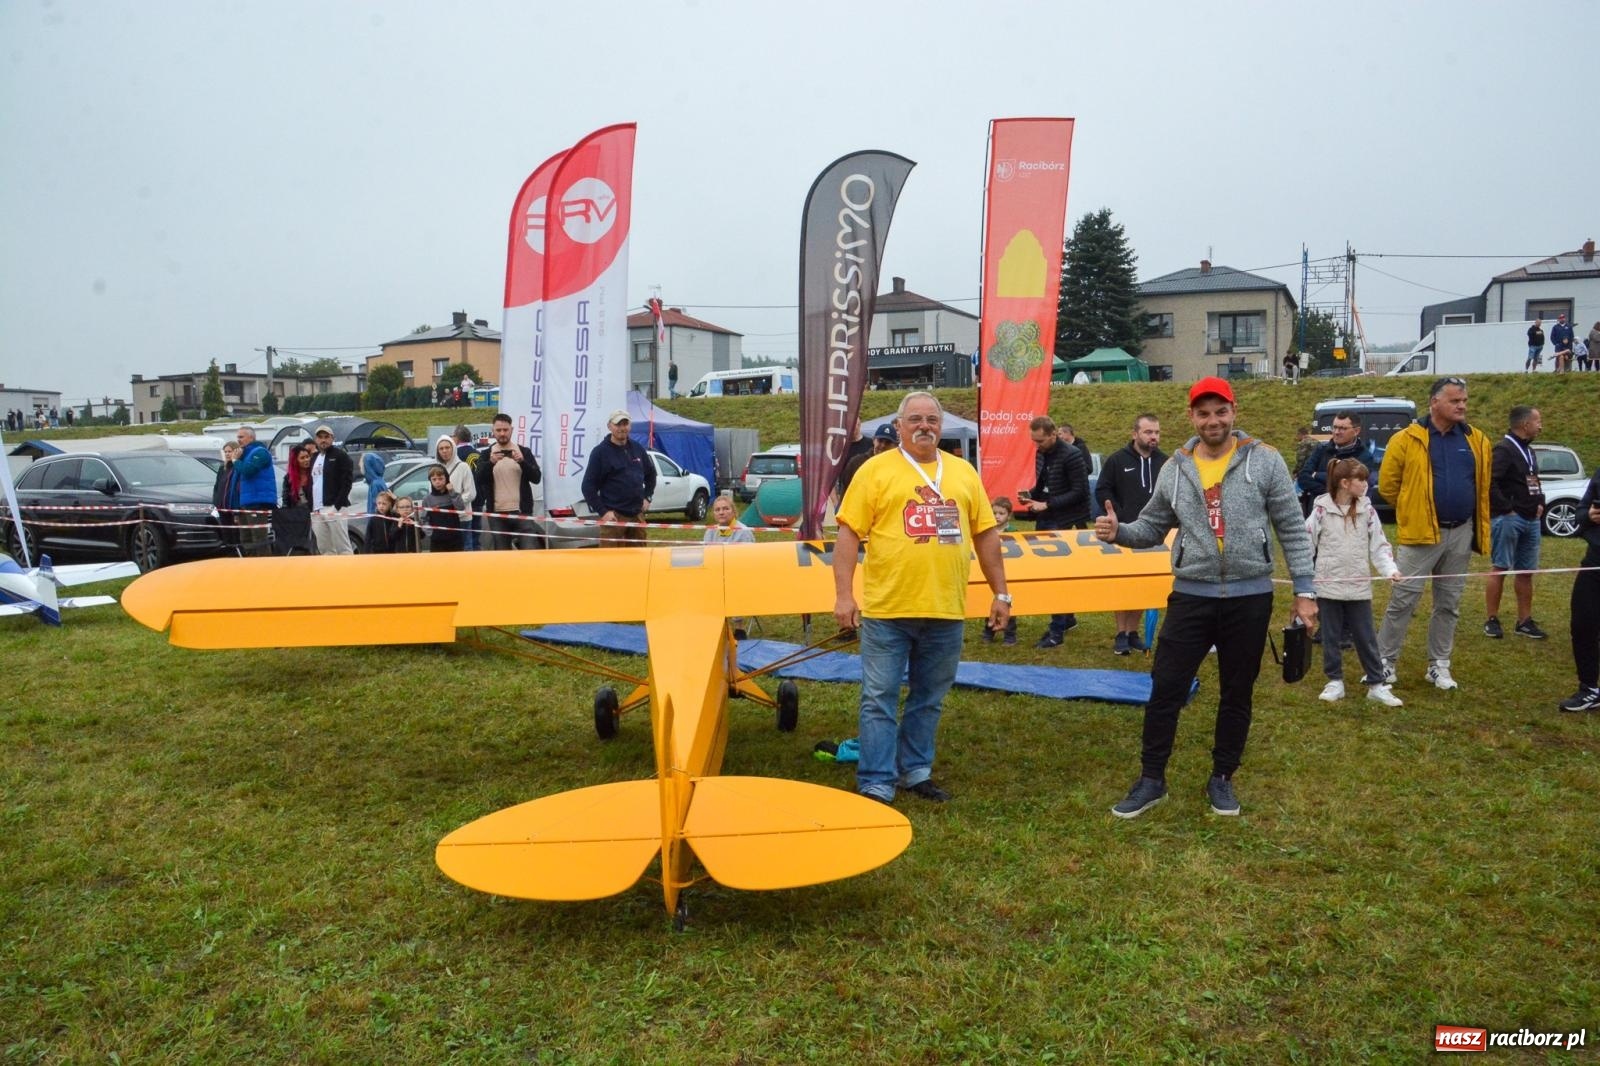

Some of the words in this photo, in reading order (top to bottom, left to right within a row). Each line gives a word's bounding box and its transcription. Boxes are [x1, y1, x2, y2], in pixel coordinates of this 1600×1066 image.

[1018, 161, 1065, 171] Racibórz
[883, 346, 920, 355] GRANITY
[923, 344, 953, 353] FRYTKI
[571, 299, 590, 477] VANESSA
[980, 409, 1013, 423] Dodaj
[559, 413, 569, 477] RADIO
